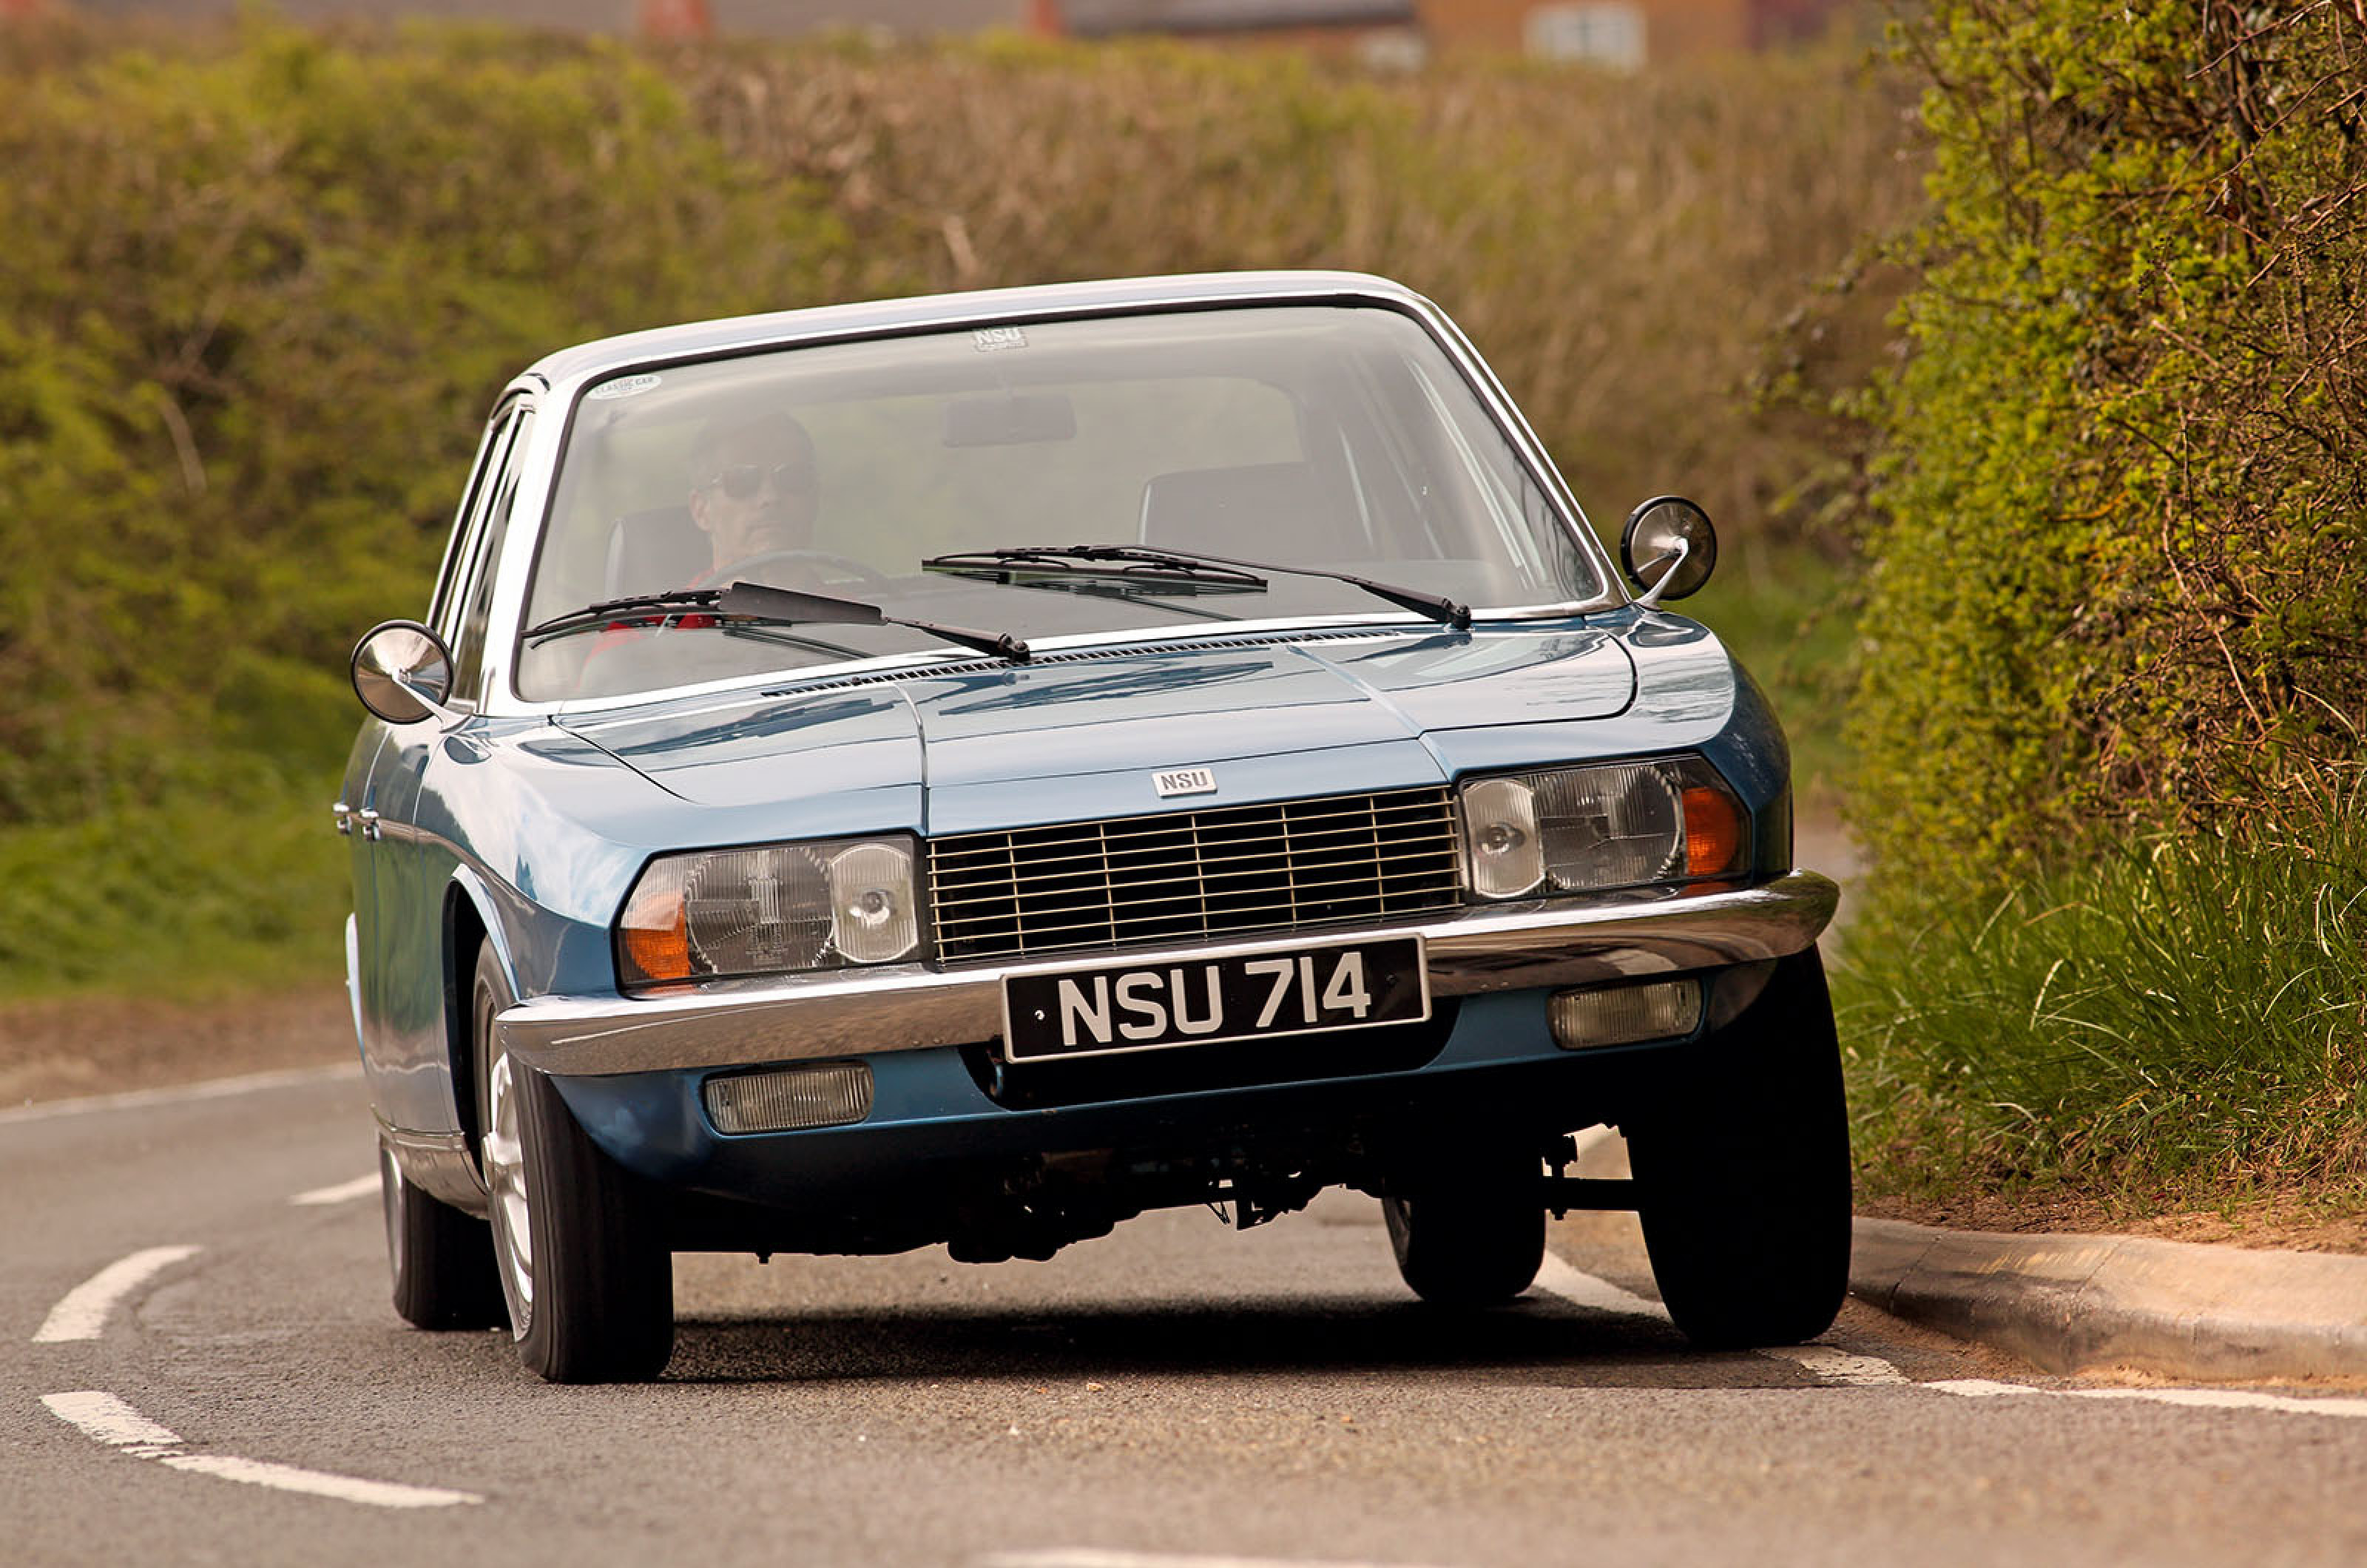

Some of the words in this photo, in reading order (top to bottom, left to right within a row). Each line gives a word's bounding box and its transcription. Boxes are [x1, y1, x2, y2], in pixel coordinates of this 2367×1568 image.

[975, 328, 1020, 344] NSU
[1161, 771, 1208, 790] NSU
[1058, 965, 1223, 1046] NSU
[1245, 952, 1371, 1028] 714
